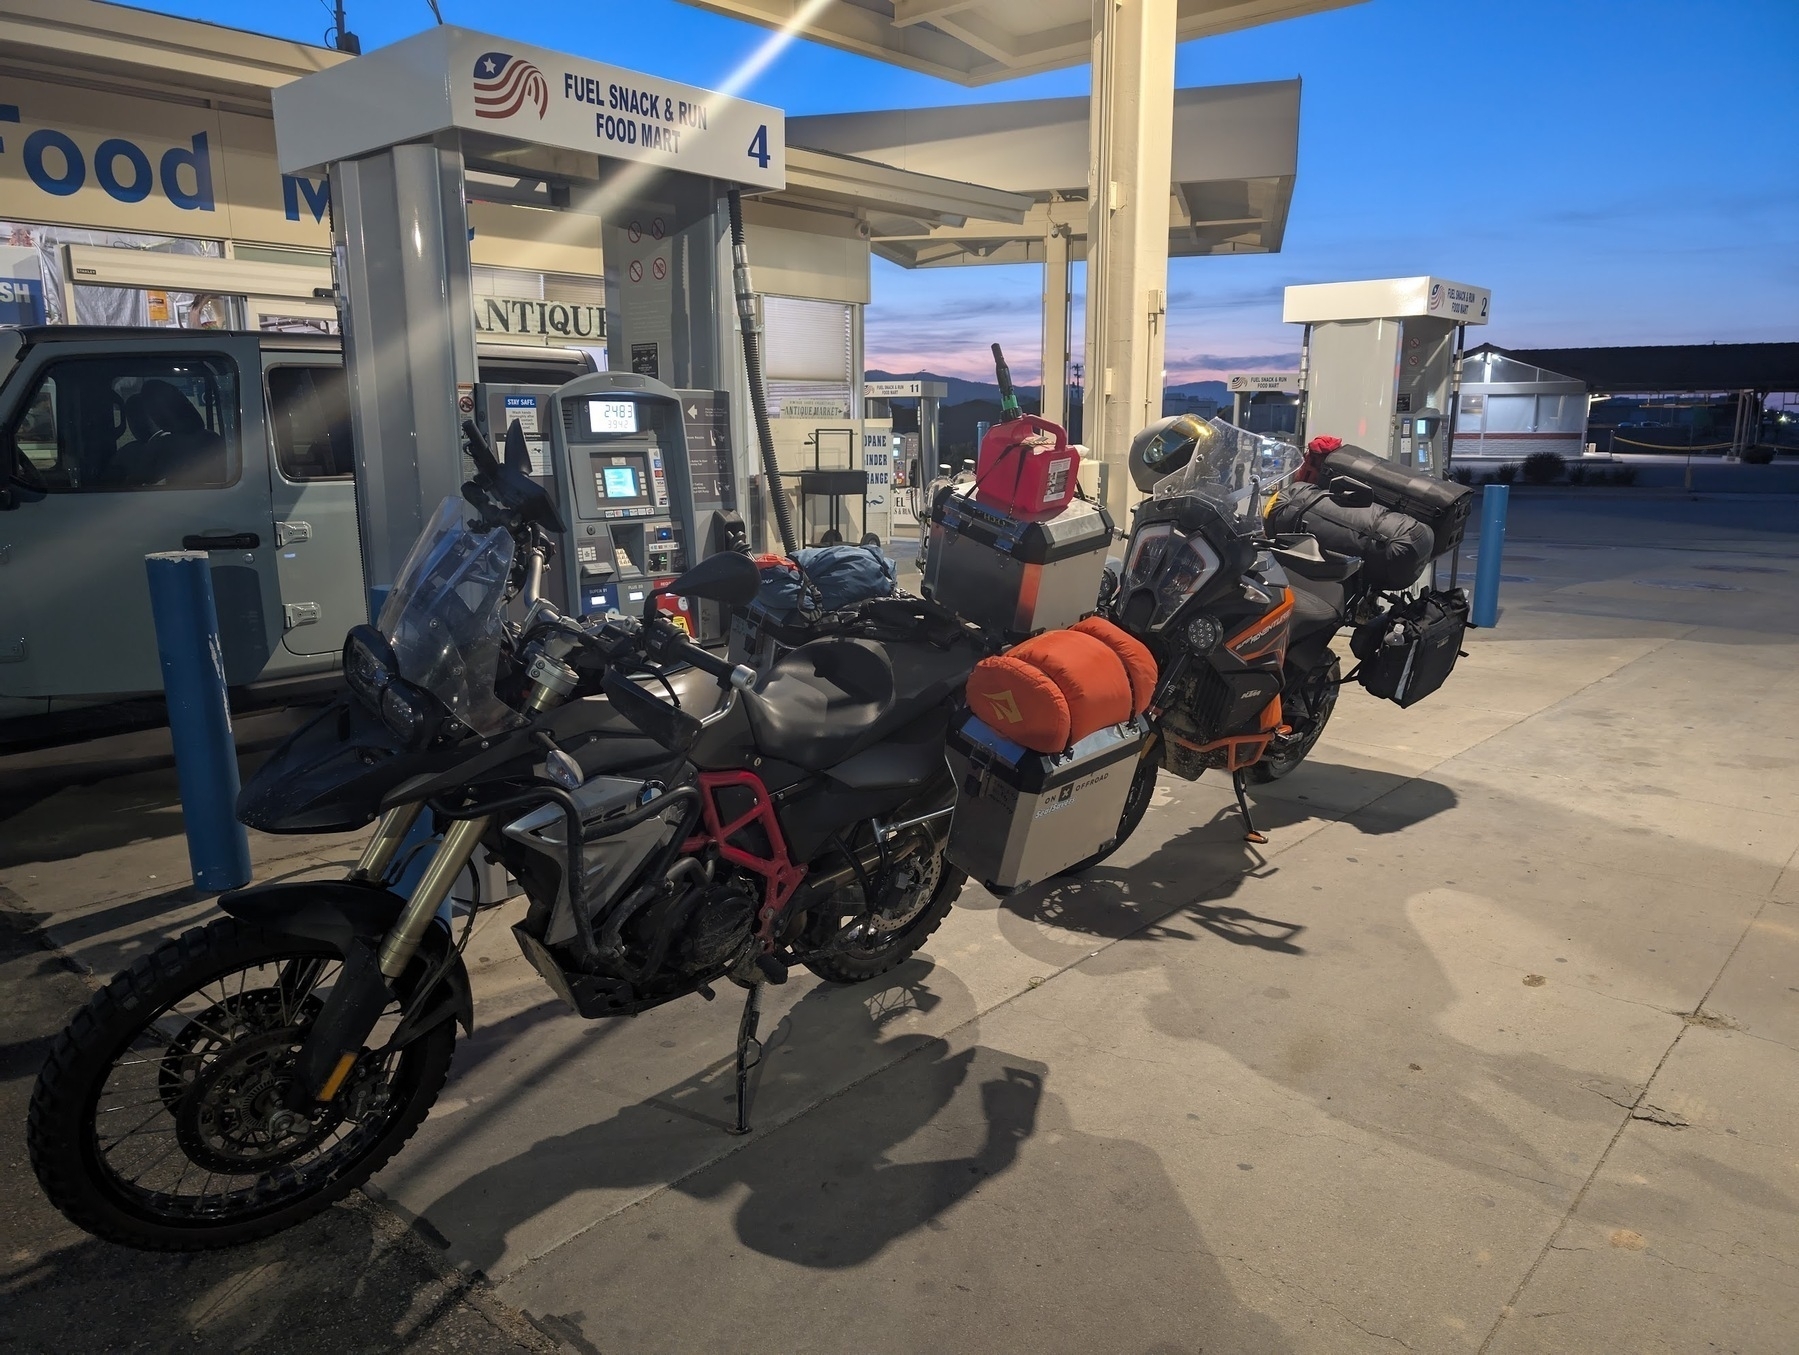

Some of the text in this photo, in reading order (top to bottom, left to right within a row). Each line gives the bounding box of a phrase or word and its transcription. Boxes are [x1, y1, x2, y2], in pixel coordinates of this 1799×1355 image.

[564, 73, 708, 130] FUEL SNACK & RUN
[596, 112, 681, 153] FOOD MART
[747, 124, 771, 169] 4
[1480, 297, 1488, 317] 2
[910, 384, 919, 393] 11
[507, 398, 520, 406] STAY
[785, 406, 839, 417] ANTIQUE MARKET
[1240, 690, 1261, 699] KTM
[1044, 794, 1057, 804] ON
[1075, 772, 1109, 791] OFFROAD
